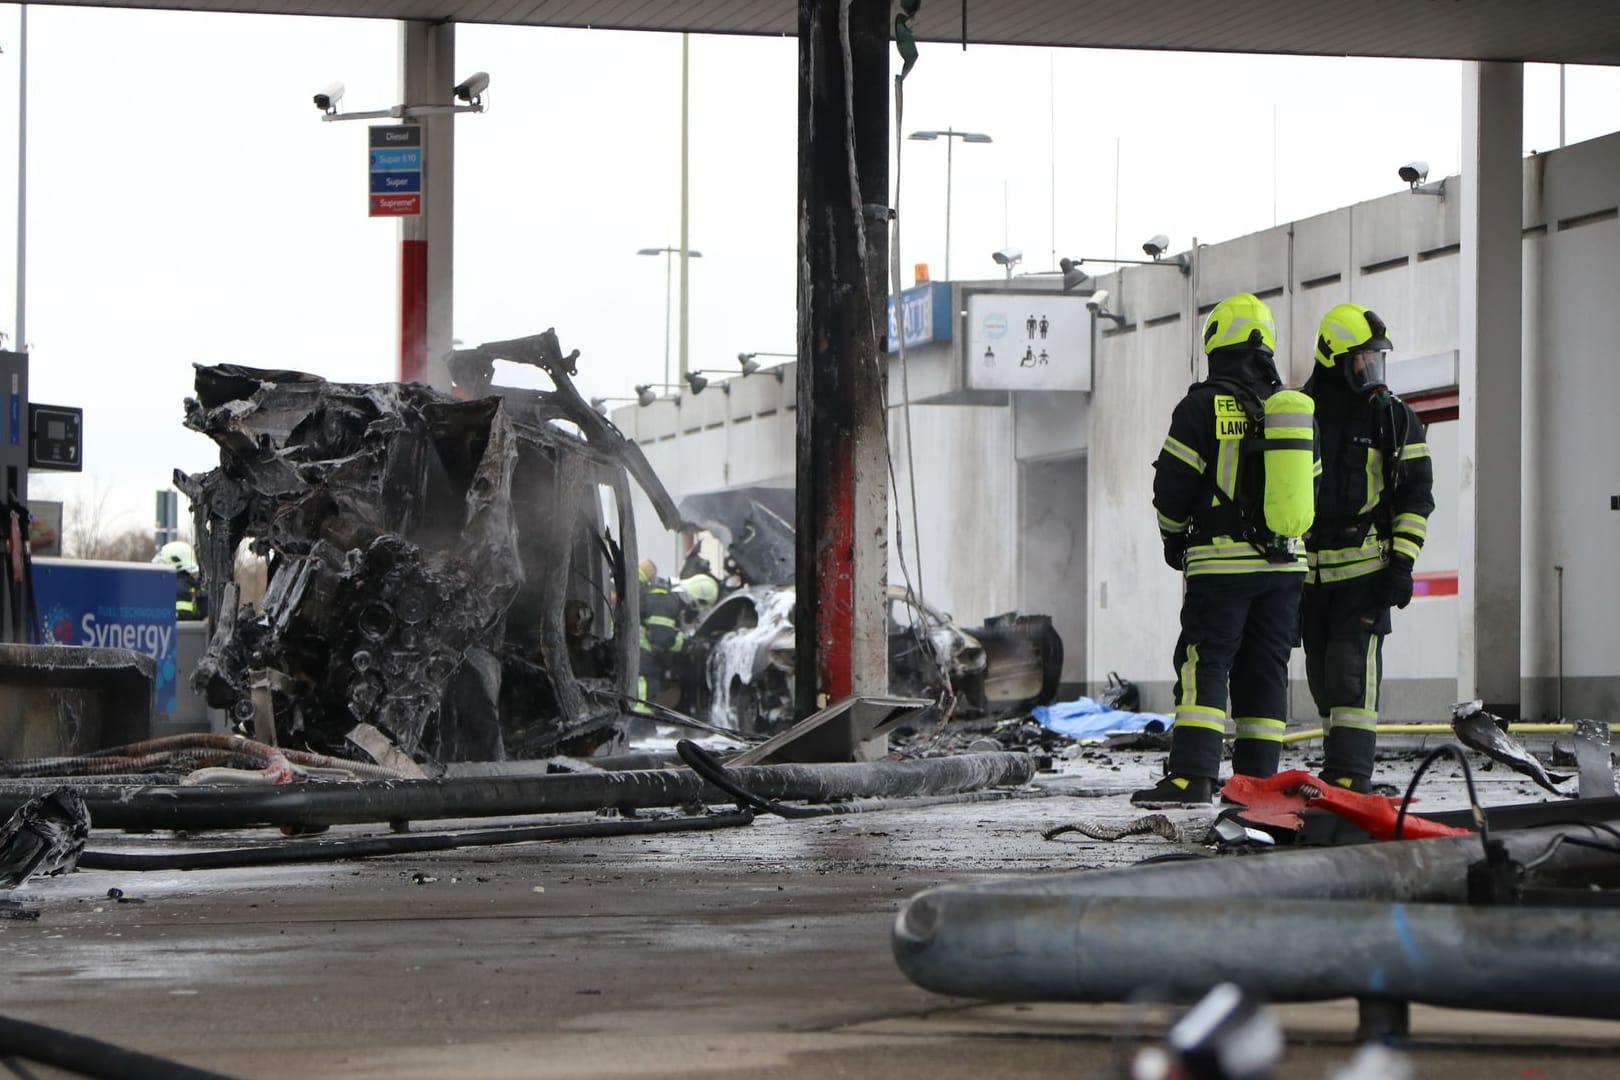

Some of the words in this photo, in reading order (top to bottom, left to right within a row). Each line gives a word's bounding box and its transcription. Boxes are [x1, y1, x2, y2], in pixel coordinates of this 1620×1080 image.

[386, 132, 408, 141] Diesel
[385, 177, 408, 187] Super
[82, 613, 172, 659] Synergy
